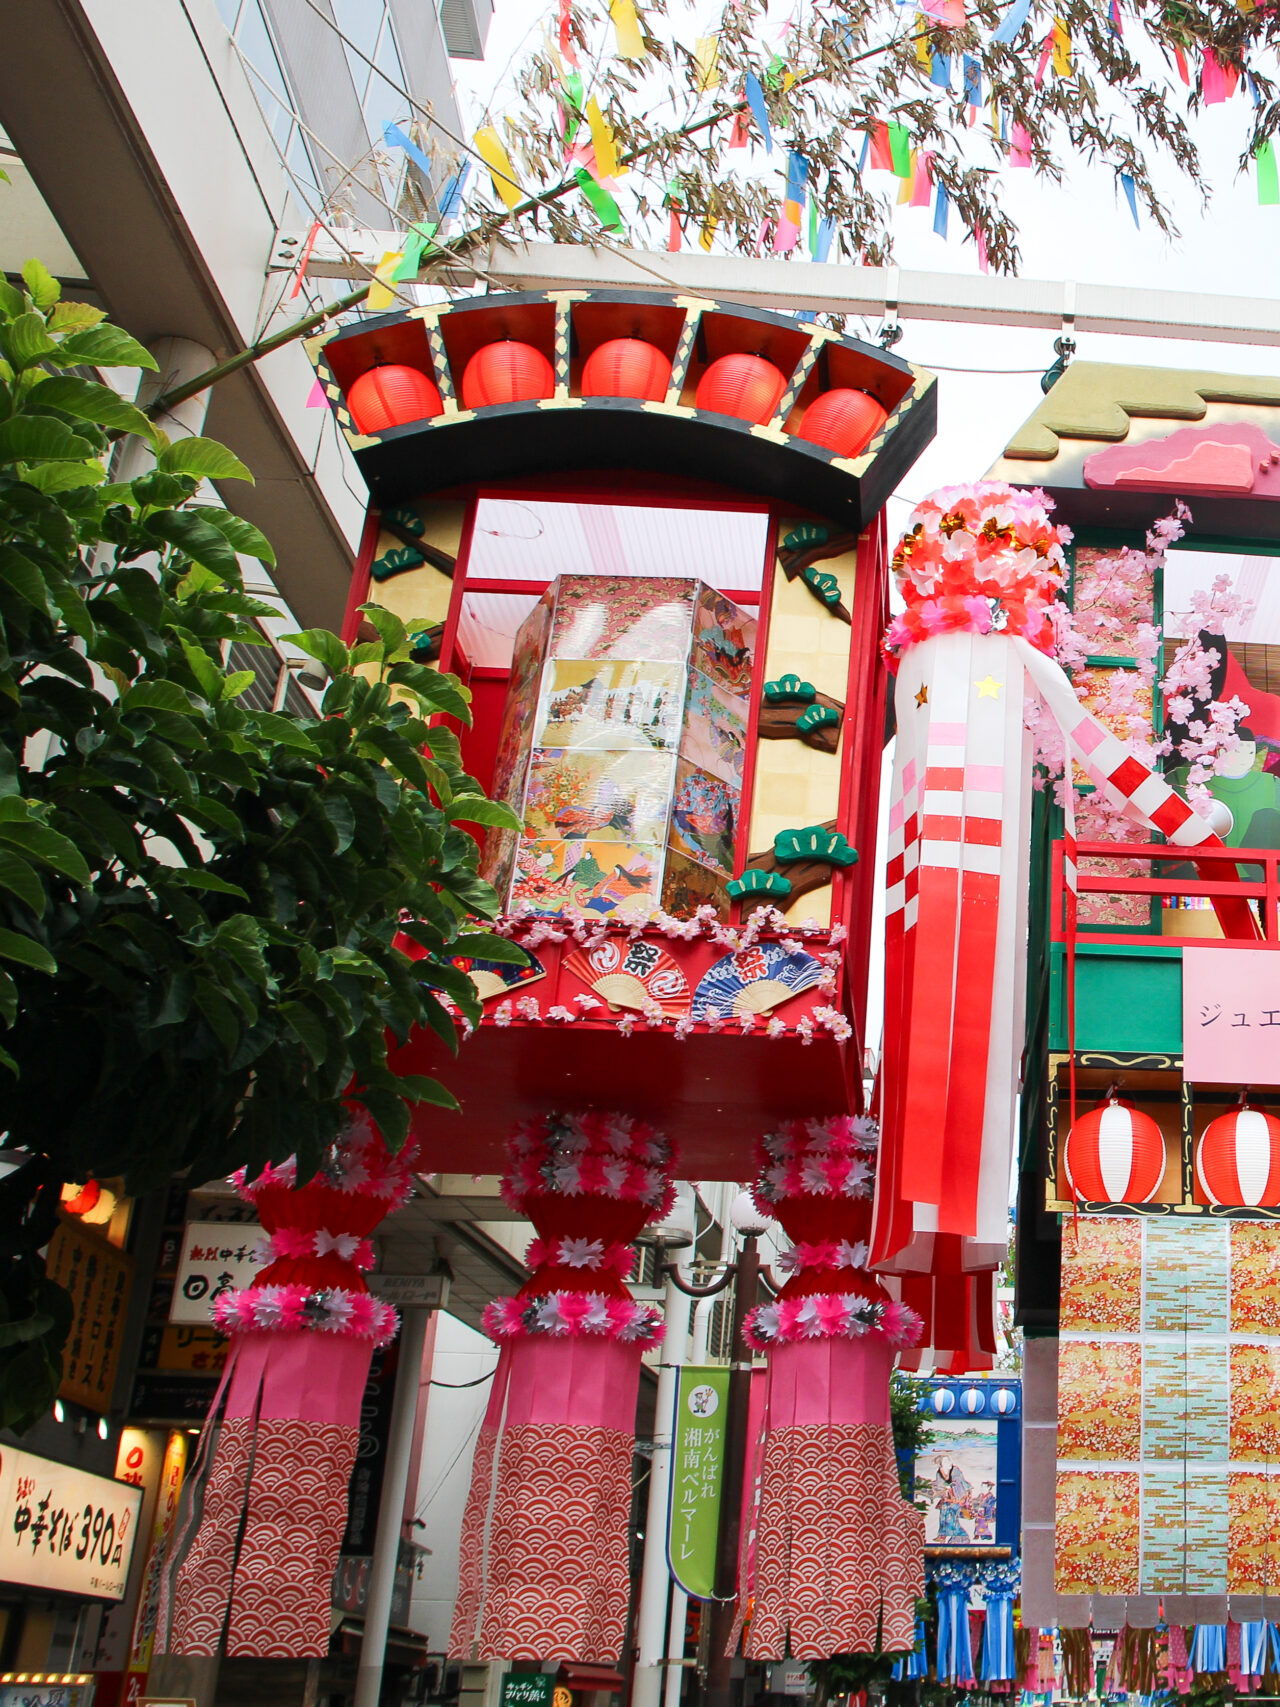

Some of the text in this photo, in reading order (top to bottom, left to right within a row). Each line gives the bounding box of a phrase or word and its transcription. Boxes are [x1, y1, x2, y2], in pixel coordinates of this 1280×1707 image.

[624, 941, 659, 977] 祭
[734, 946, 769, 983] 祭
[701, 1428, 720, 1499] がんばれ
[680, 1427, 703, 1560] 湘南ベルマーレ
